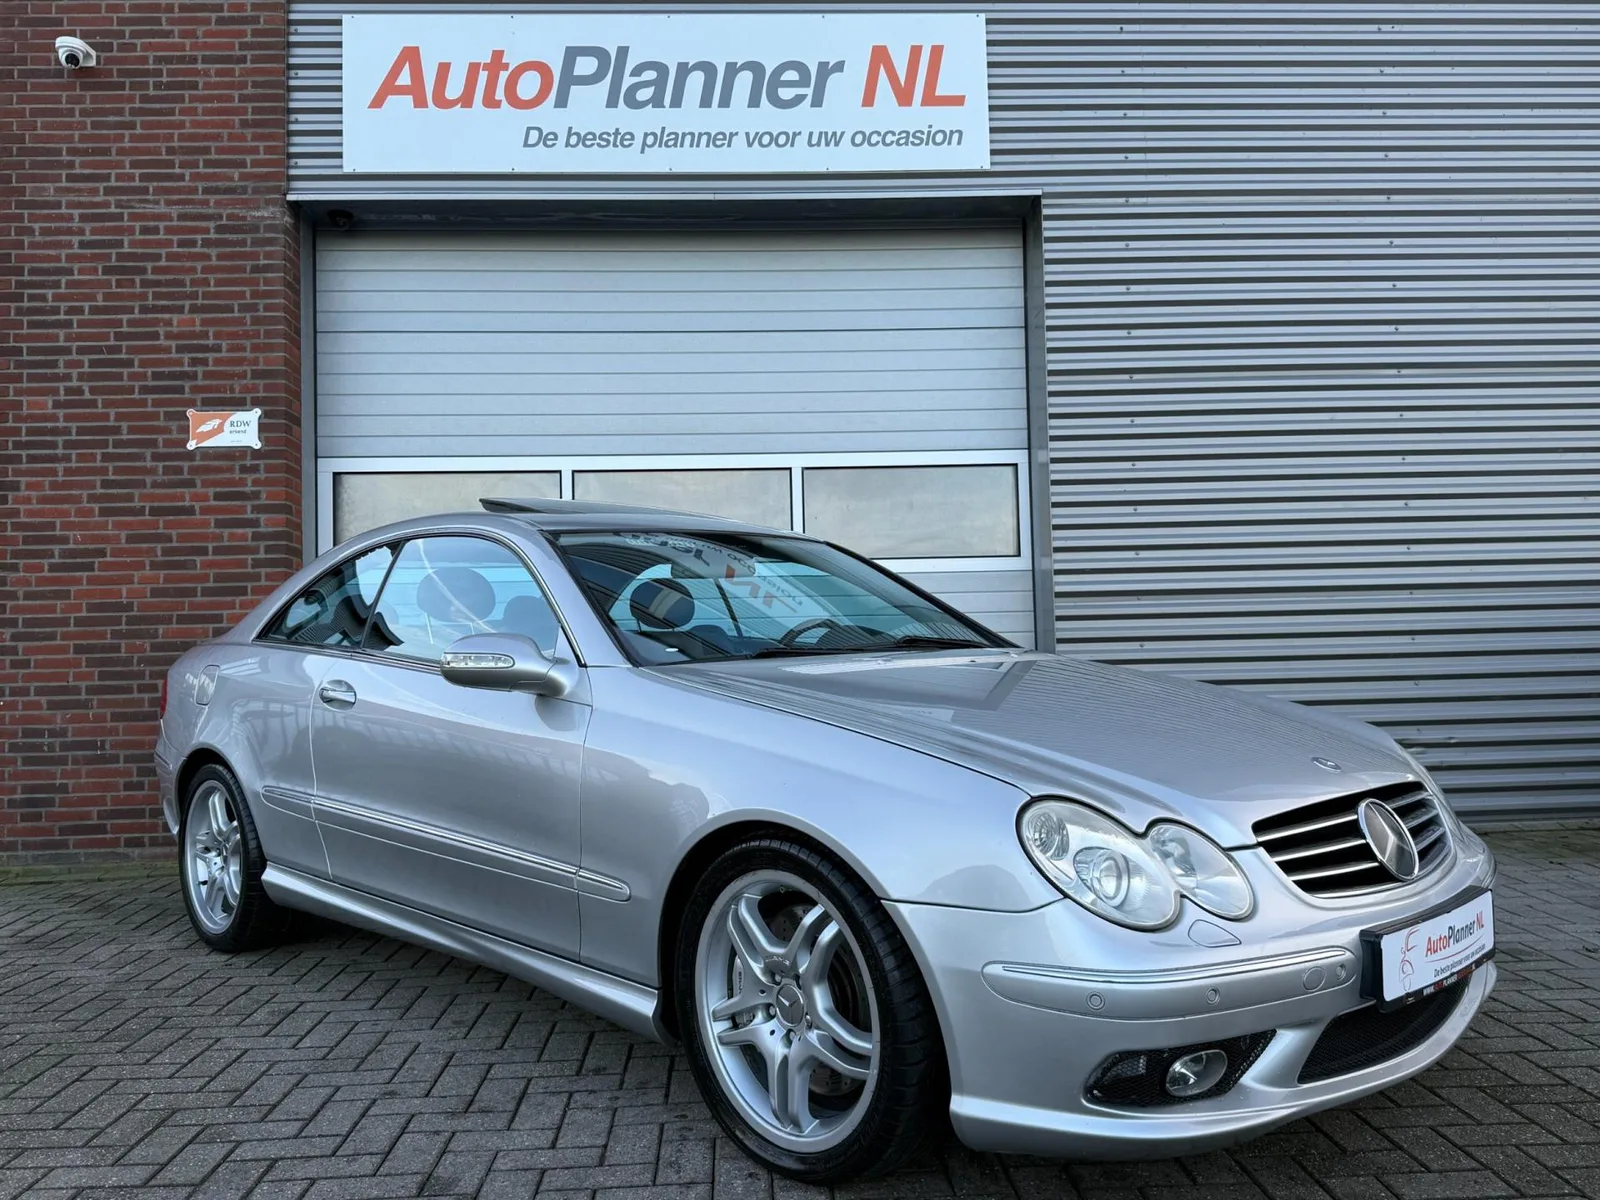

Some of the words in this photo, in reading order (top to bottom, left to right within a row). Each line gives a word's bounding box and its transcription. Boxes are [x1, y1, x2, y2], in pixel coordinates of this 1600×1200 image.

[368, 45, 846, 109] AutoPlanner
[861, 45, 966, 107] NL
[523, 126, 559, 149] De
[565, 127, 635, 150] beste
[639, 128, 740, 155] planner
[745, 131, 802, 148] voor
[807, 131, 846, 148] uw
[851, 125, 964, 149] occasion
[229, 420, 251, 428] RDW
[1425, 920, 1475, 957] AutoPlanner
[1476, 910, 1484, 931] NL
